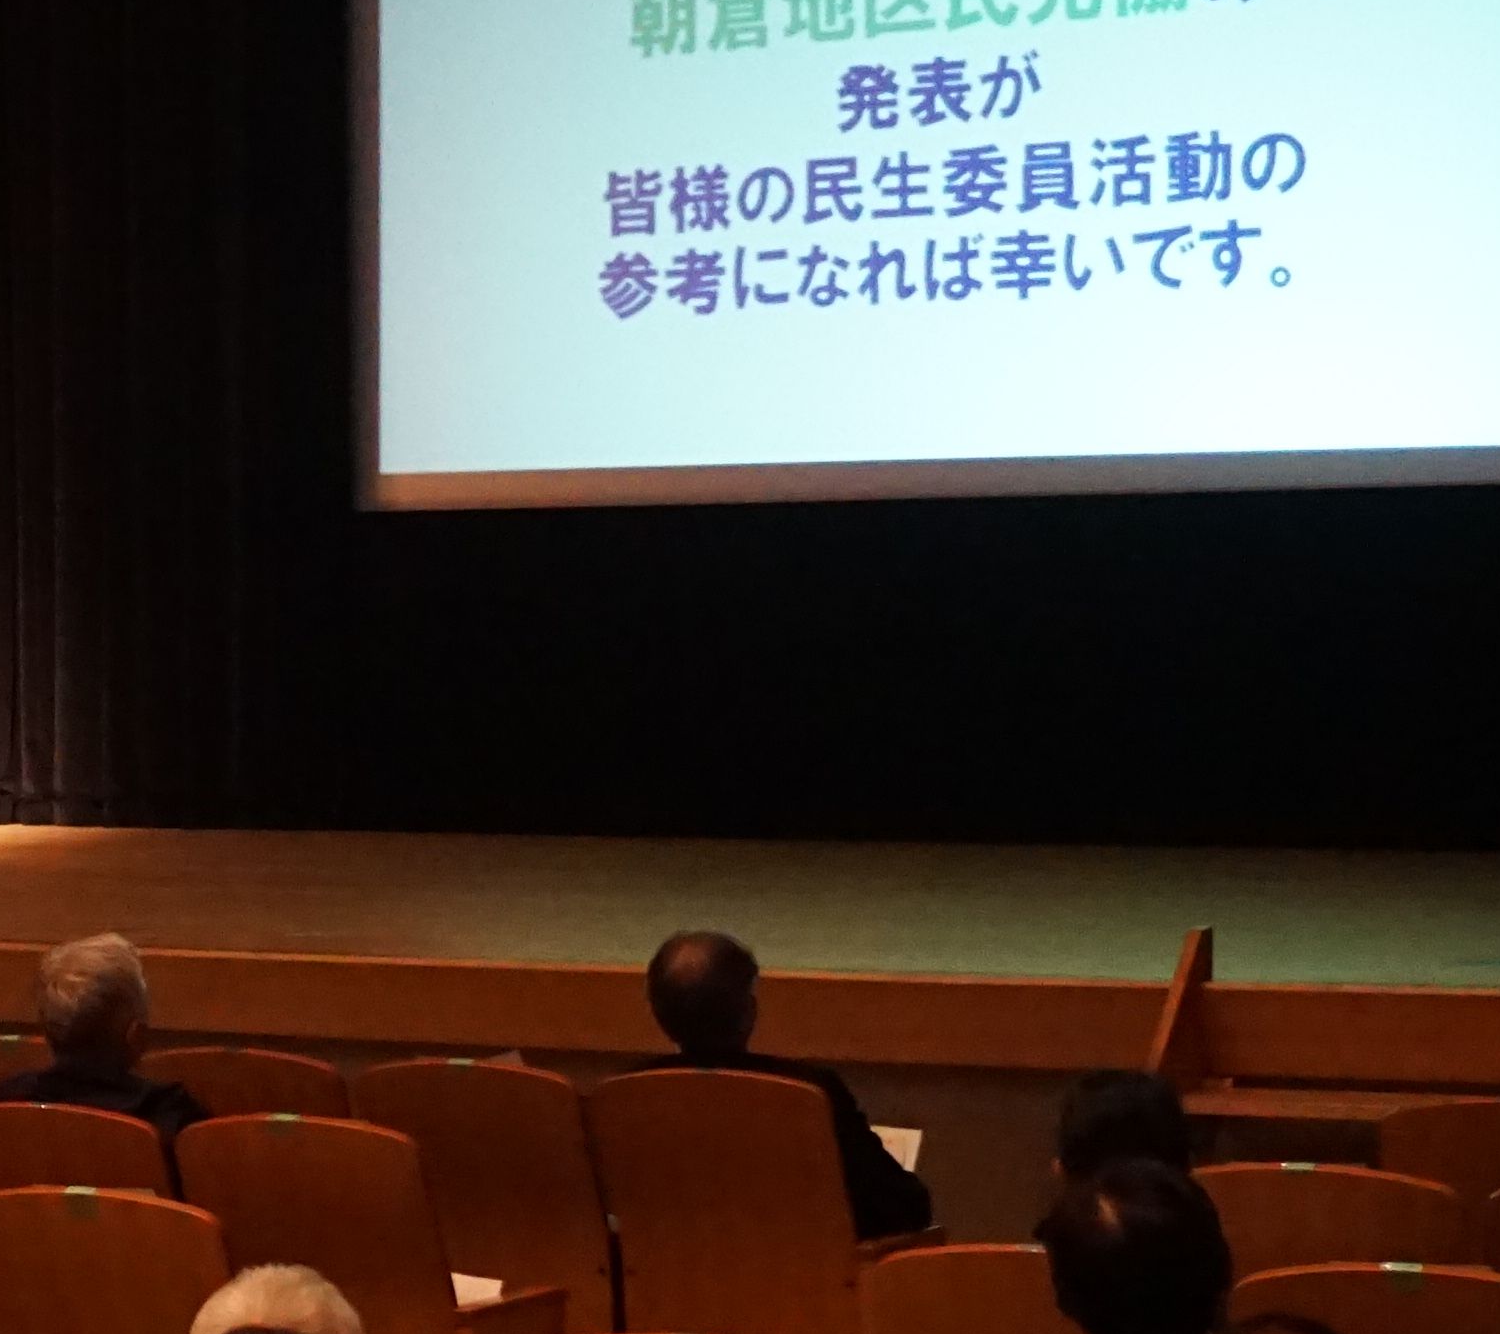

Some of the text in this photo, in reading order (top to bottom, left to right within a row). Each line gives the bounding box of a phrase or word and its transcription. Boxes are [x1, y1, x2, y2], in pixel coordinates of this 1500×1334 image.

[837, 50, 1042, 133] 発表が
[604, 130, 1306, 237] 皆様の民生委員活動の
[599, 219, 1291, 319] 参考になれば幸いです。
